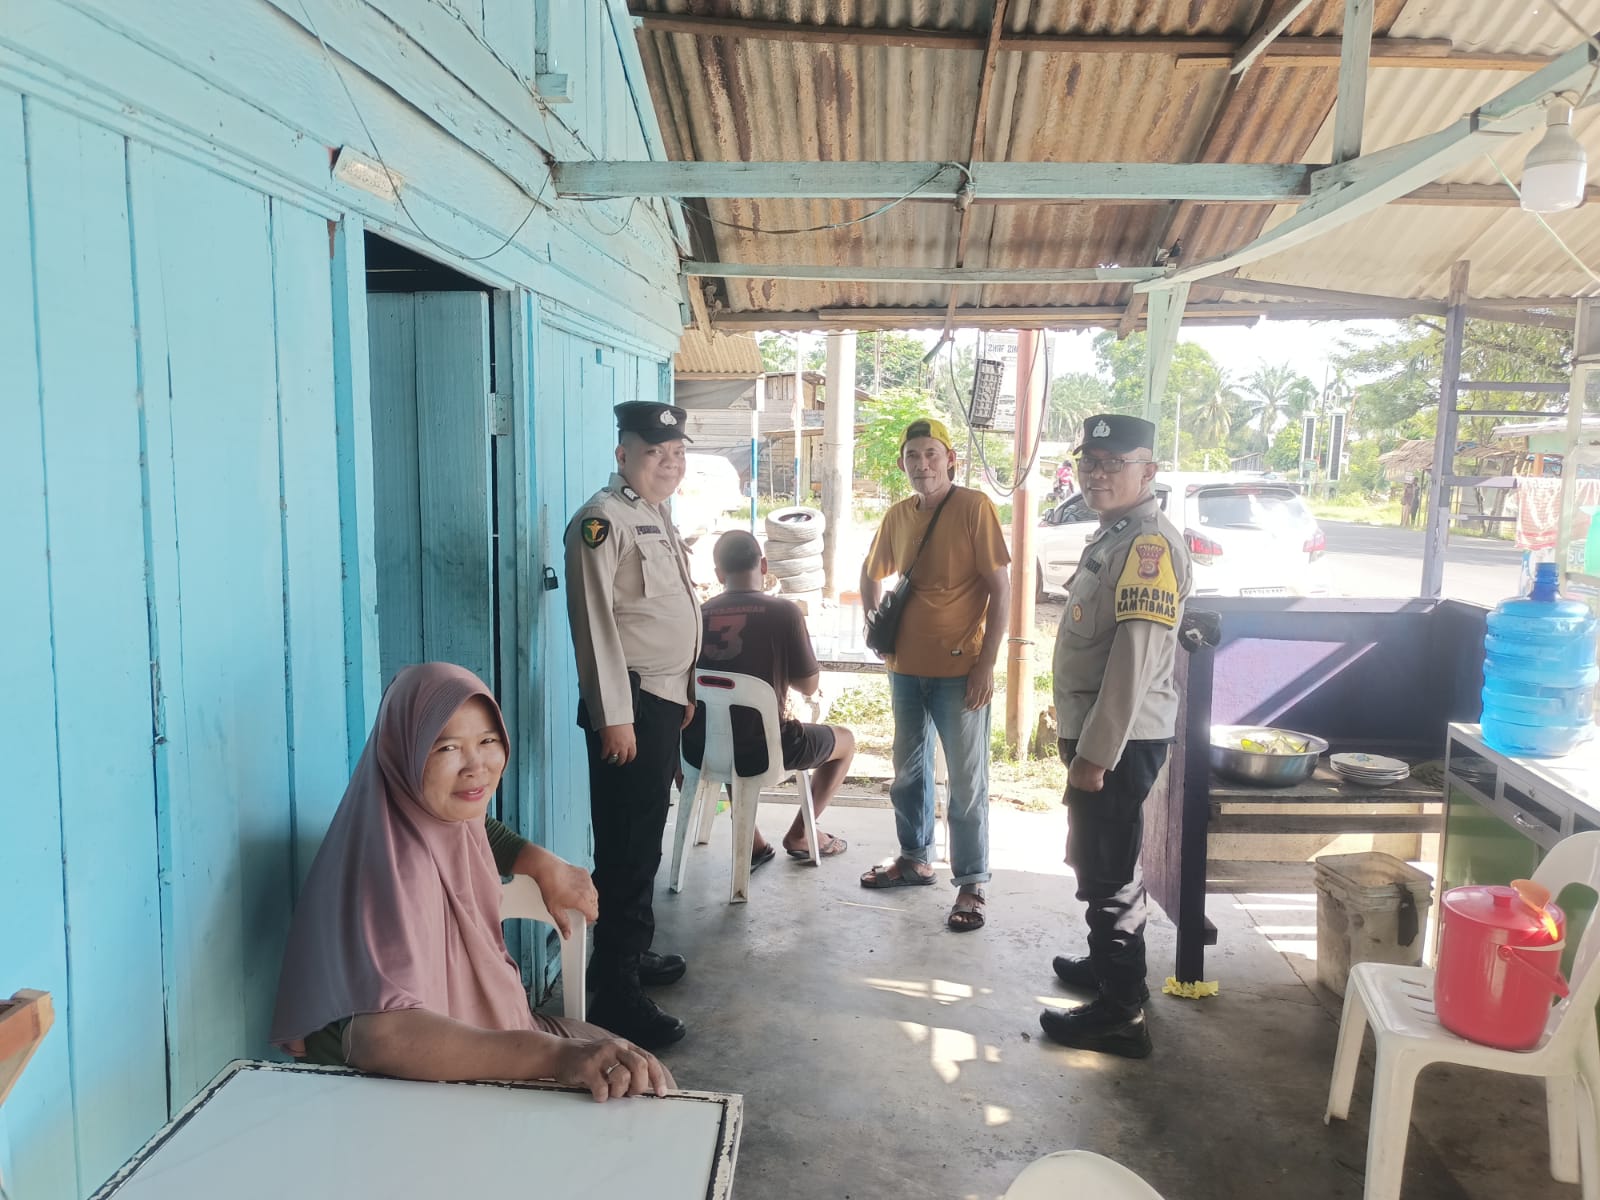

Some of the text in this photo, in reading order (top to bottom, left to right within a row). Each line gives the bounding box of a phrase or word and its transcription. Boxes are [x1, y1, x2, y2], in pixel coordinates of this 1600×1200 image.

[1121, 587, 1174, 604] BHABIN
[1117, 599, 1176, 618] KAMTIBMAS
[703, 614, 747, 661] 3
